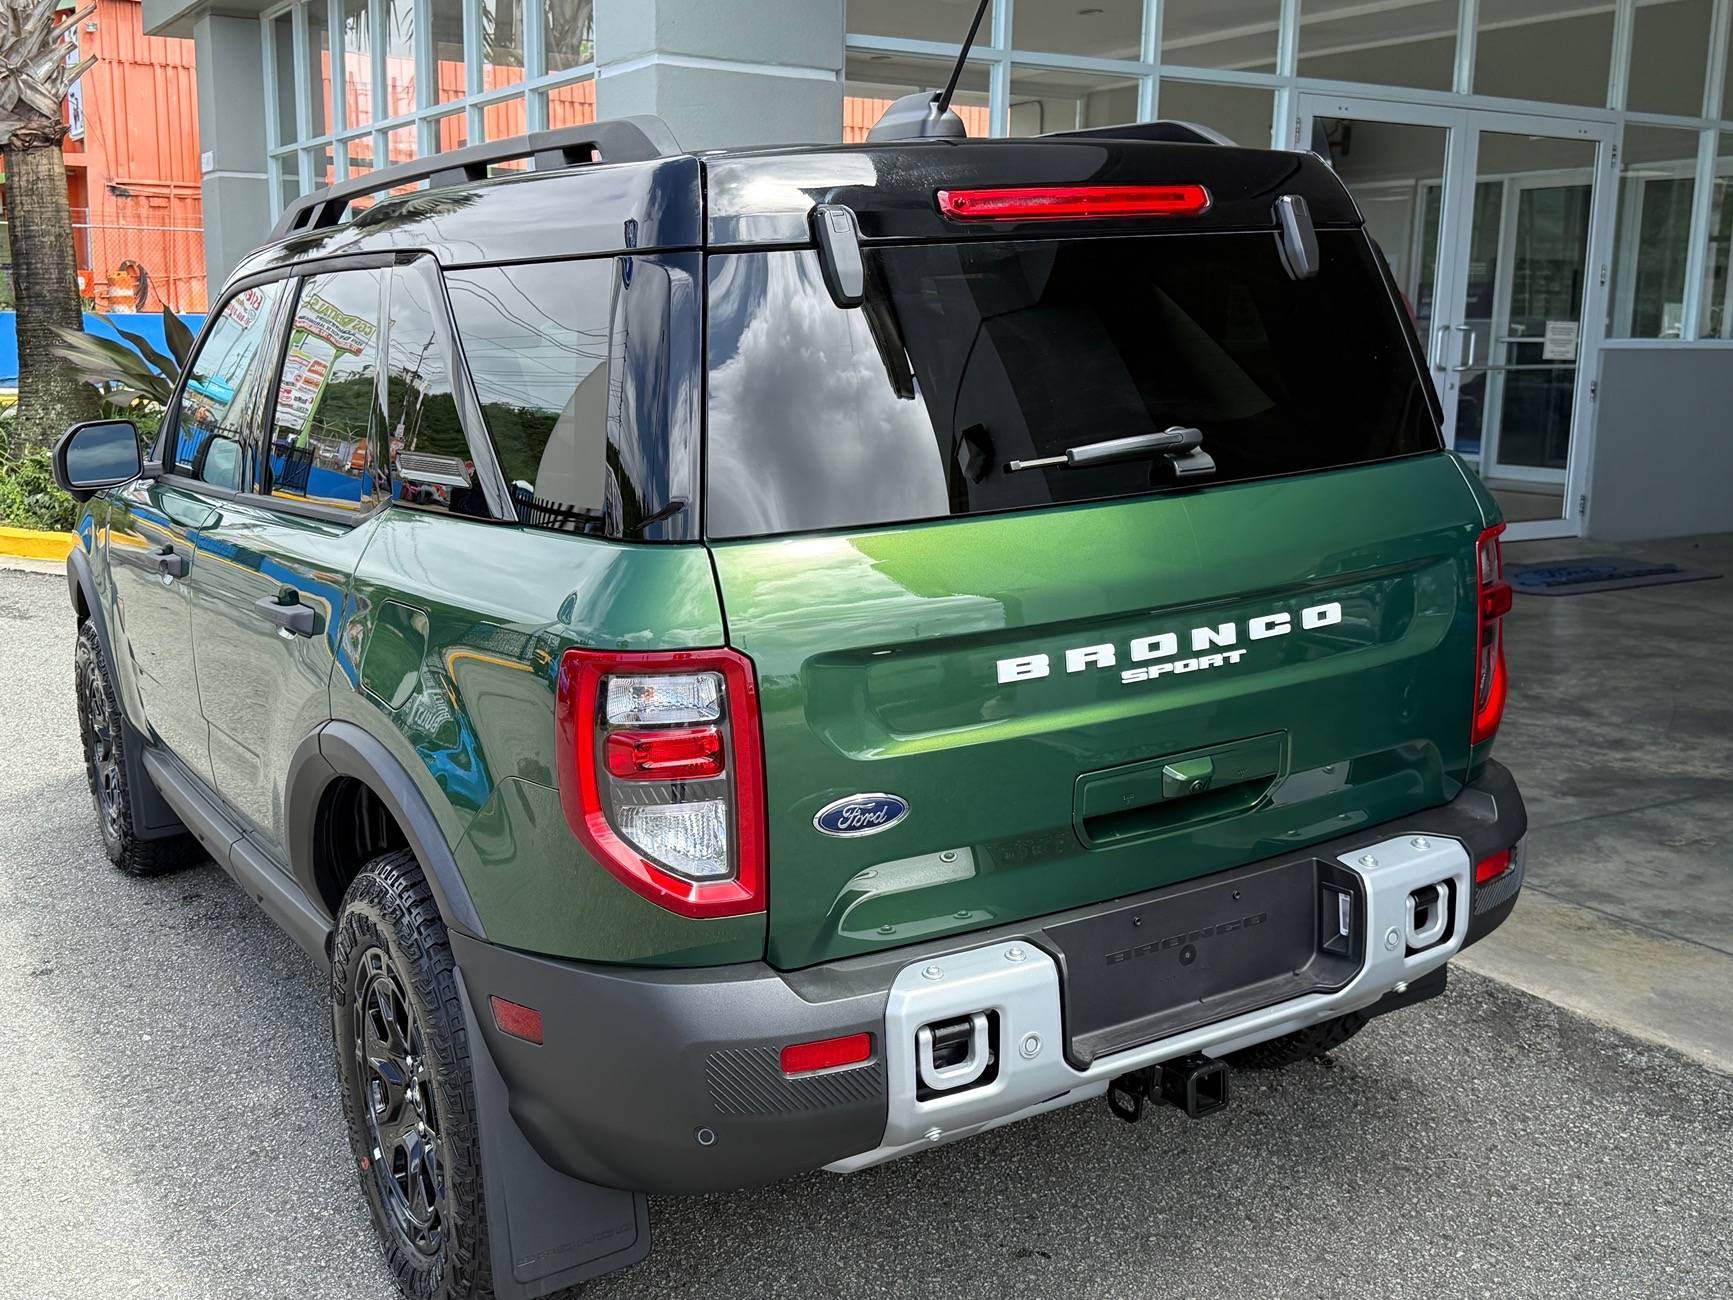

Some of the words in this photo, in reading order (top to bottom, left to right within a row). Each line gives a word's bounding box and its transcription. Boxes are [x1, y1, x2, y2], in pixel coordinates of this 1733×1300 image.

[996, 601, 1343, 685] BRONCO
[1120, 648, 1248, 685] SPORT
[837, 802, 889, 829] Ford
[1104, 912, 1268, 966] BRONCO
